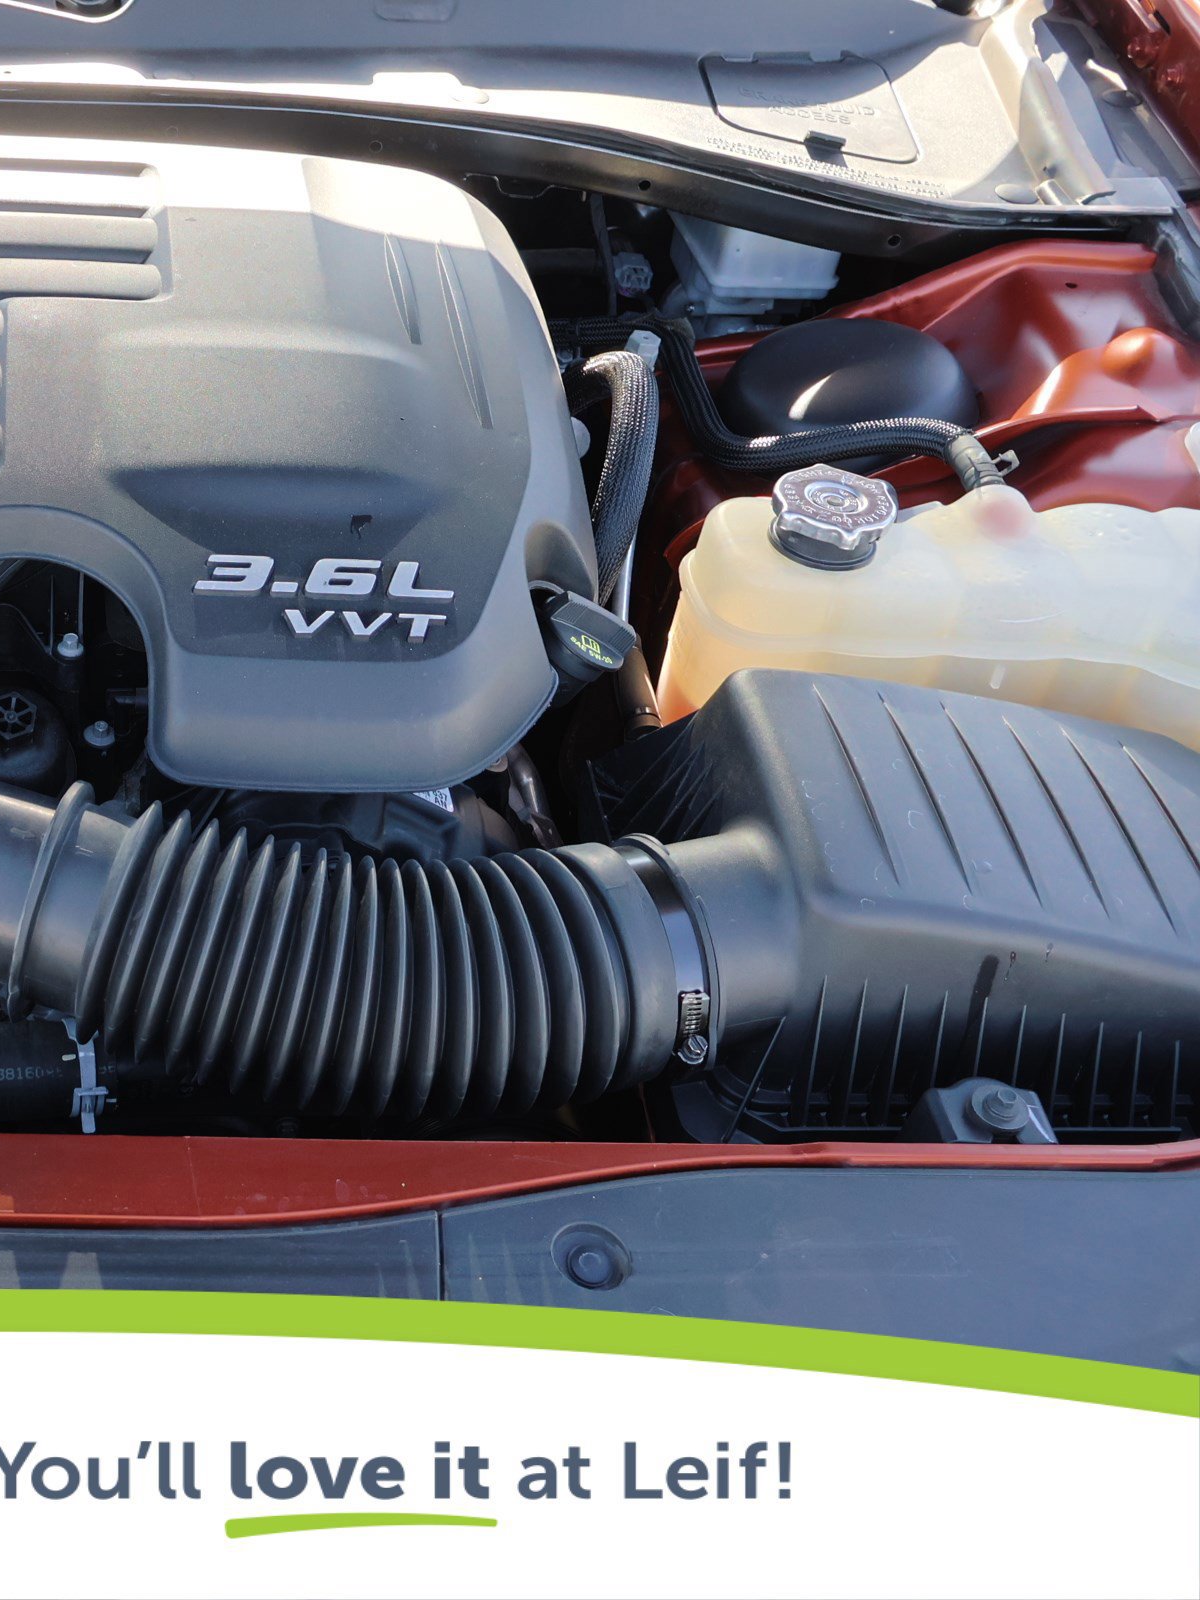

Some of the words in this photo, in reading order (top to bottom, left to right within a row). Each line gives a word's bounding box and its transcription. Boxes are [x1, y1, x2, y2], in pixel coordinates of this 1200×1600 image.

[737, 85, 809, 107] BRAKE
[815, 101, 876, 117] FLUID
[768, 106, 852, 125] ACCESS
[193, 554, 455, 600] 3.6L
[284, 609, 447, 643] VVT
[570, 636, 588, 653] SAE
